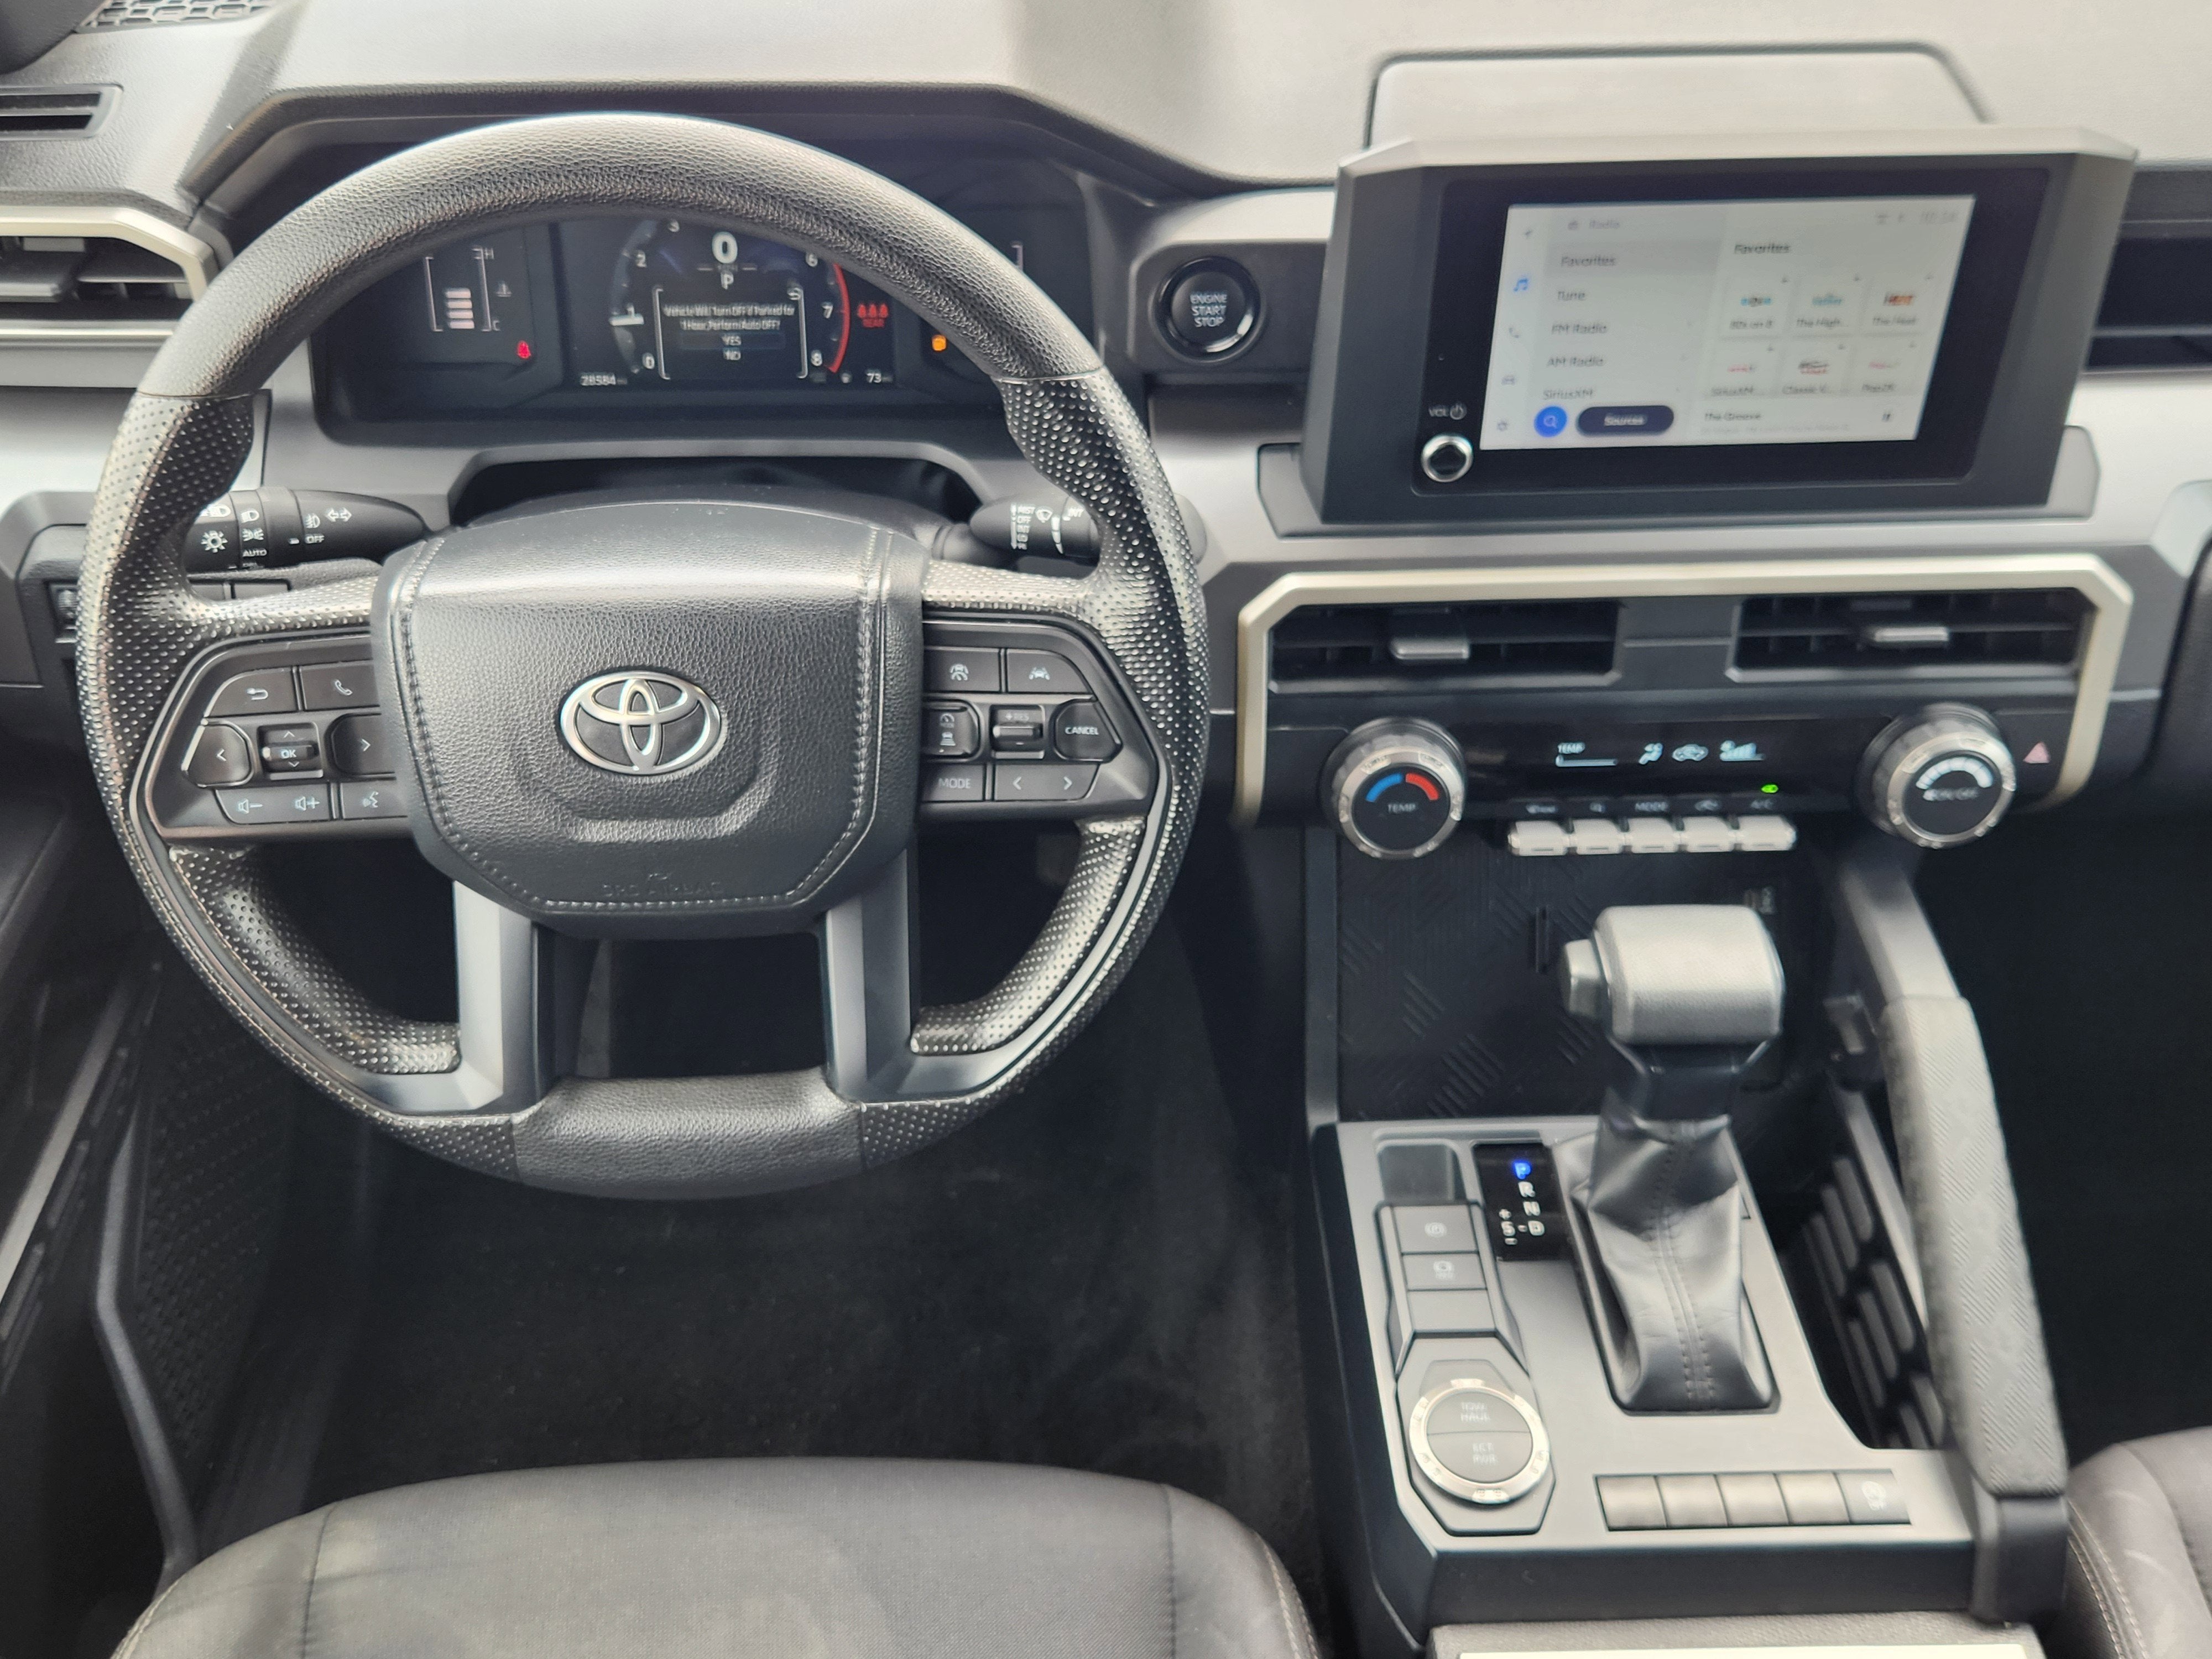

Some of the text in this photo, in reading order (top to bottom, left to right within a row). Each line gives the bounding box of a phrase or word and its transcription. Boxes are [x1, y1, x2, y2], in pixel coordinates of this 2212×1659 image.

[712, 231, 738, 264] 0
[1734, 241, 1791, 254] Favorites
[637, 250, 646, 268] 2
[806, 253, 818, 267] 6
[1560, 255, 1617, 268] Favorites
[721, 270, 734, 289] P
[1190, 294, 1227, 304] ENGINE
[1557, 290, 1587, 301] Tune
[822, 302, 834, 319] 7
[1192, 305, 1227, 316] START
[1194, 316, 1225, 327] STOP
[722, 333, 742, 346] YES
[811, 350, 823, 367] 8
[867, 371, 881, 383] 73
[305, 534, 325, 544] OFF
[242, 549, 268, 557] AUTO
[1065, 726, 1099, 736] CANCEL
[281, 749, 297, 759] OK
[1557, 742, 1585, 754] TEMP
[939, 777, 971, 790] MODE
[1387, 803, 1416, 813] TEMP
[1513, 1161, 1531, 1180] P
[1518, 1181, 1535, 1197] R
[1523, 1201, 1541, 1216] N
[1501, 1221, 1515, 1237] S
[1528, 1220, 1545, 1236] D
